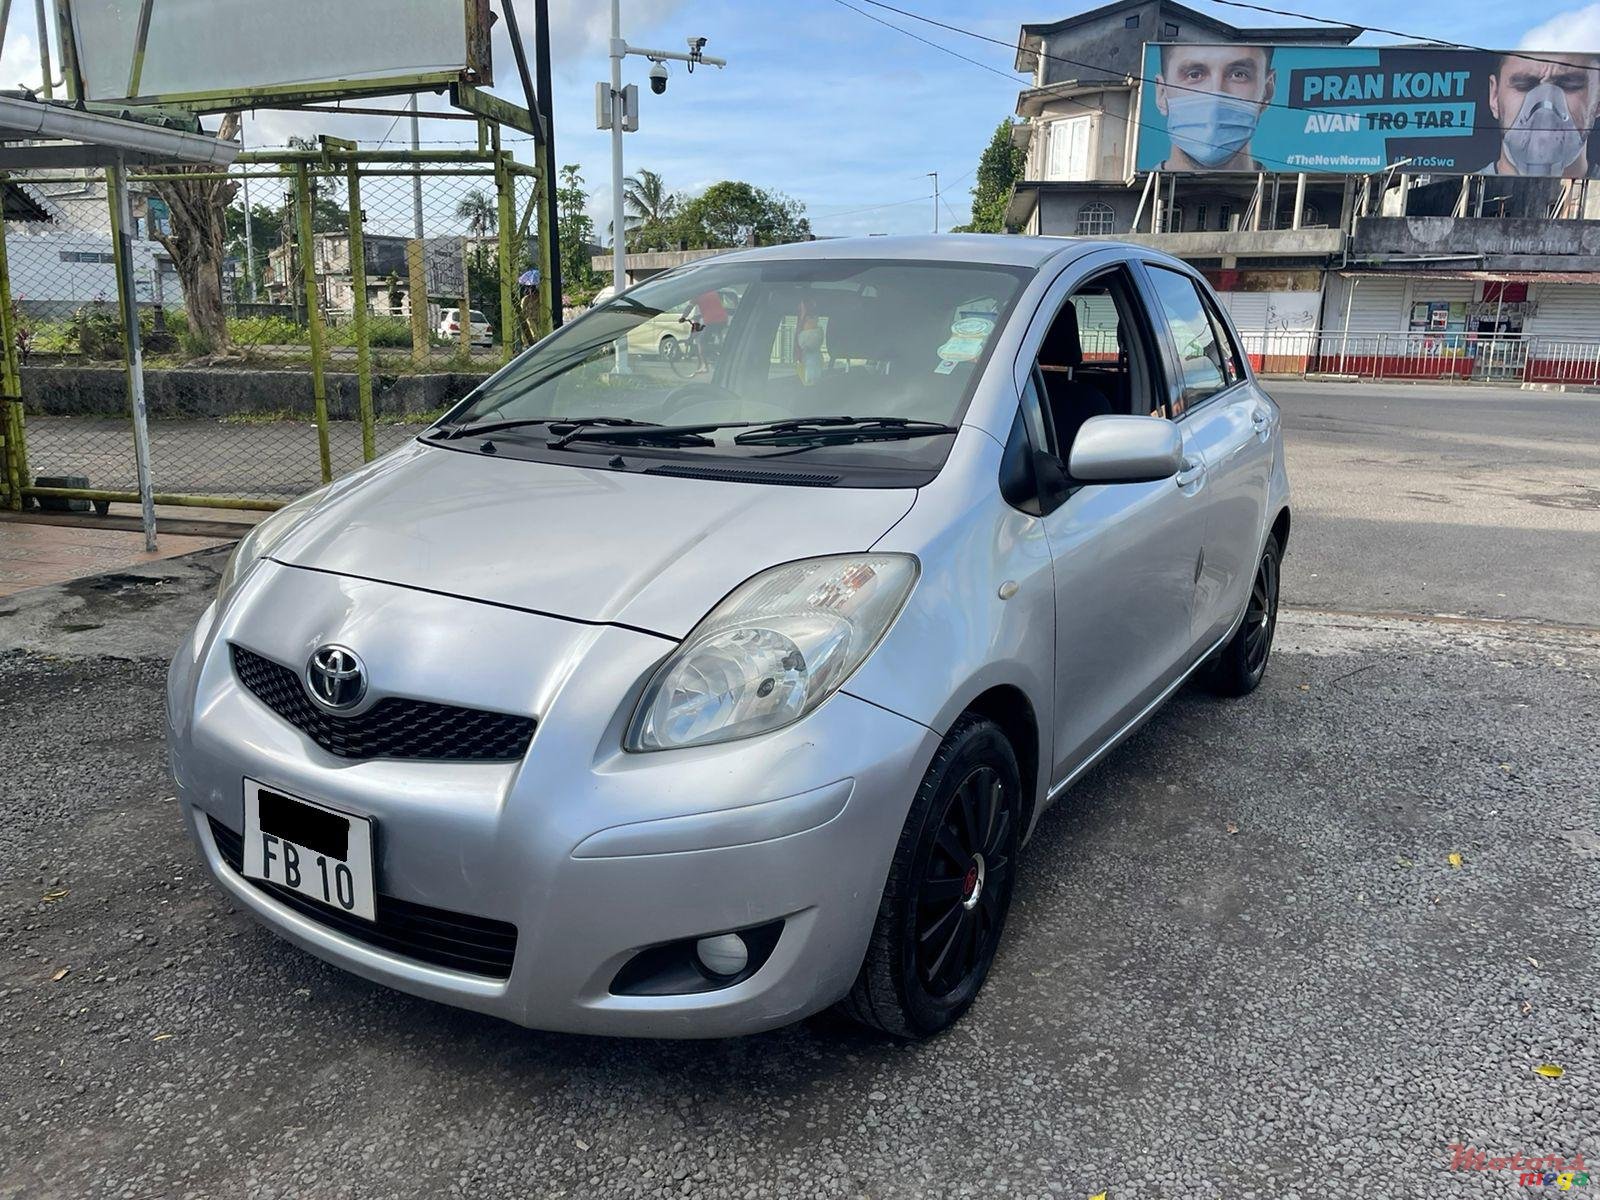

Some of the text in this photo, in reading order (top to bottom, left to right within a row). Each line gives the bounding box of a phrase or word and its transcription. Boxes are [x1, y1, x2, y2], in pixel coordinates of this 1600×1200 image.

[1303, 71, 1470, 102] PRAN KONT
[1304, 113, 1360, 134] AVAN
[1366, 111, 1408, 130] TRO
[1414, 110, 1454, 128] TAR
[1286, 155, 1381, 166] #TheNewNormal
[262, 833, 355, 911] FB 10
